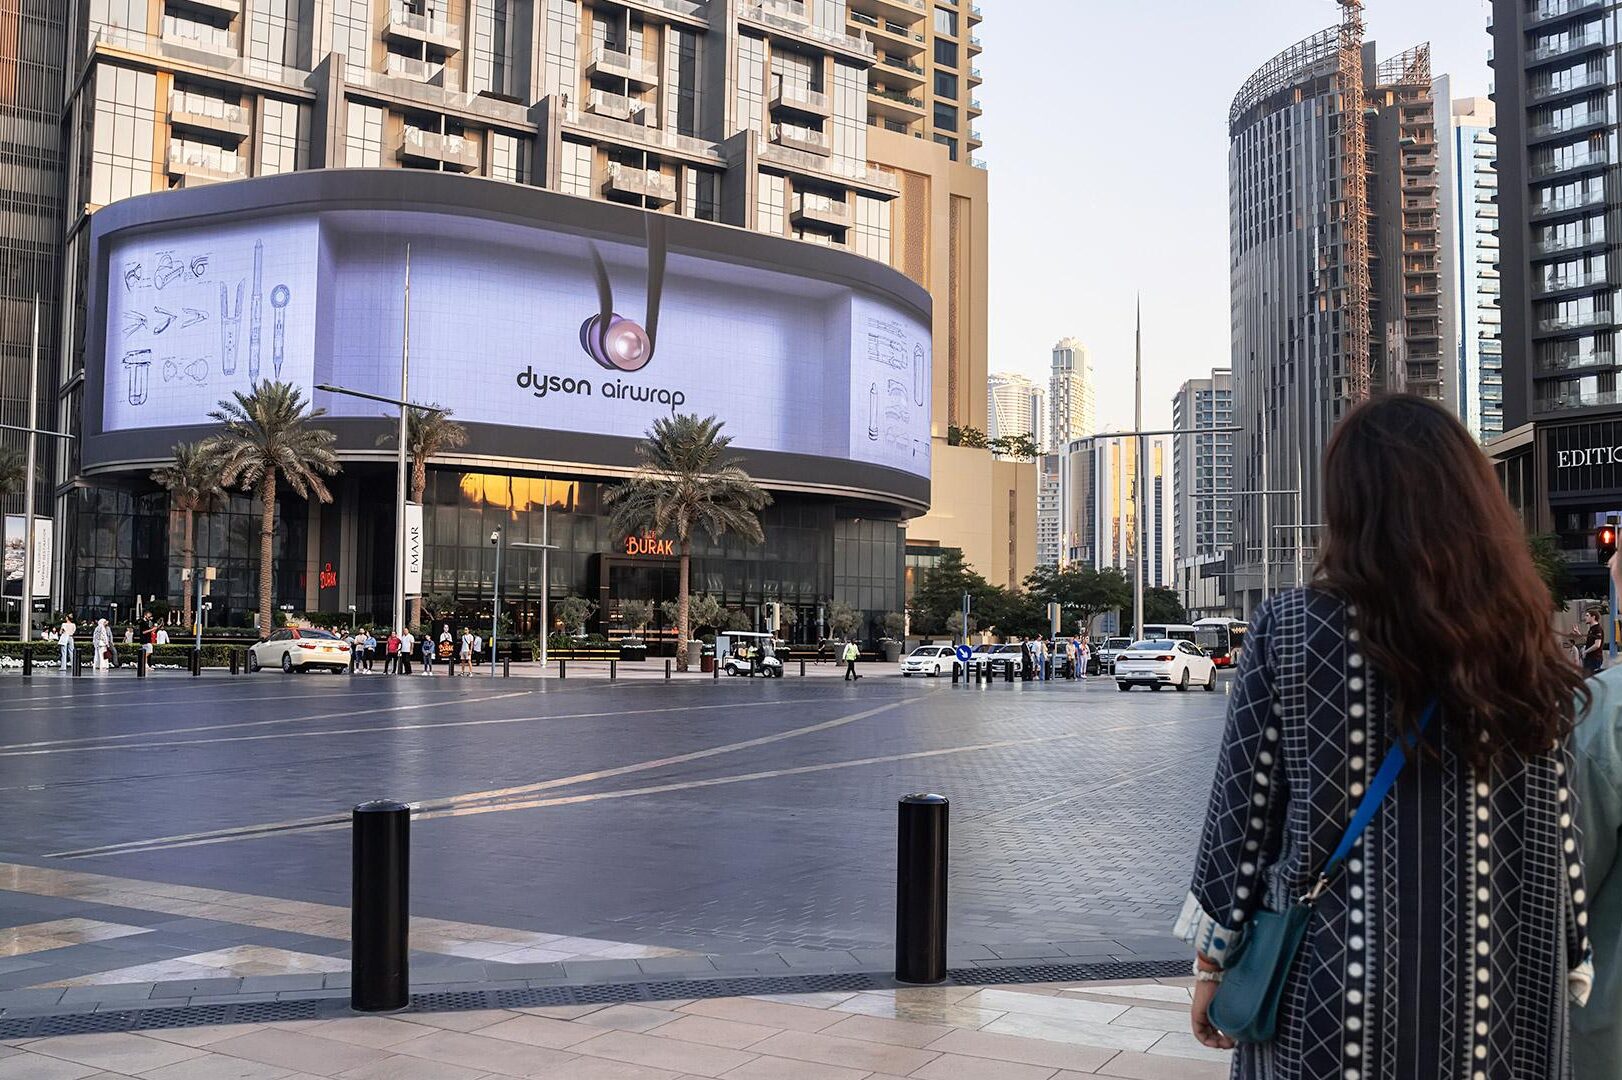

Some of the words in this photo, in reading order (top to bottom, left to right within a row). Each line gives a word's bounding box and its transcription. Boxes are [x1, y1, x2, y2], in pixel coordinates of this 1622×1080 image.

[516, 365, 592, 398] dyson
[601, 378, 686, 411] airwrap
[410, 527, 419, 573] EMAAR
[625, 536, 674, 556] BURAK
